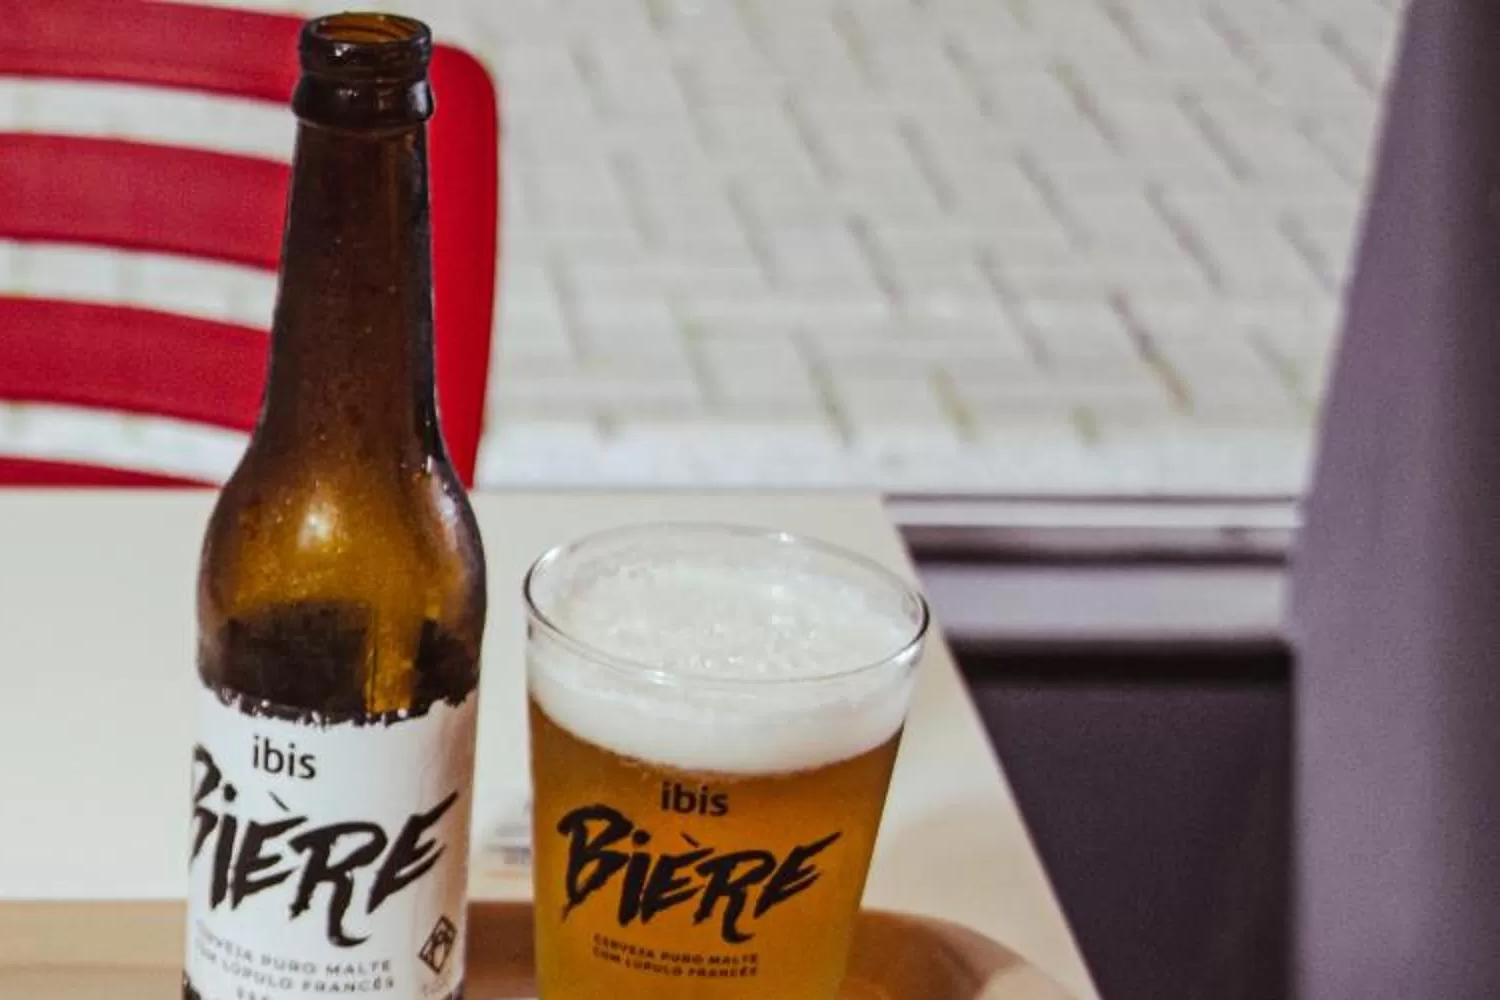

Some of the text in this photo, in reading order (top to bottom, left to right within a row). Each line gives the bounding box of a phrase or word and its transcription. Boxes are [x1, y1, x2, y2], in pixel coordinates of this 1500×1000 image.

[252, 735, 317, 780] ibis
[660, 781, 730, 817] ibis
[260, 952, 318, 975] PURO
[325, 959, 392, 977] MALTE
